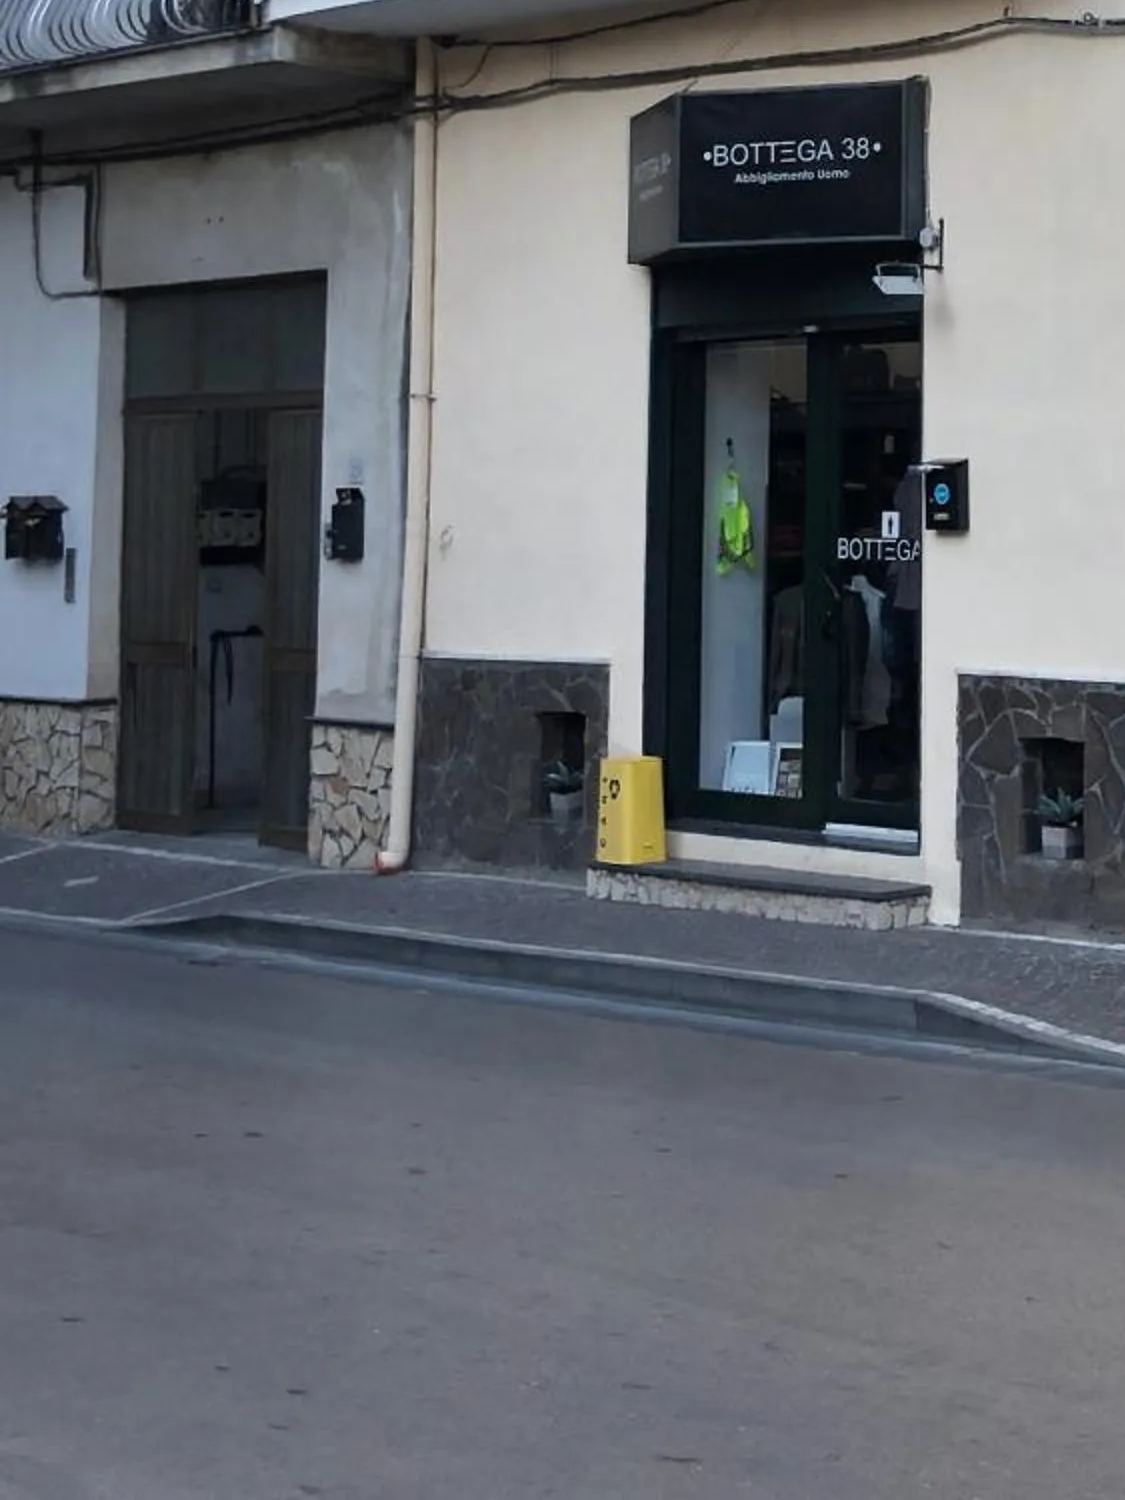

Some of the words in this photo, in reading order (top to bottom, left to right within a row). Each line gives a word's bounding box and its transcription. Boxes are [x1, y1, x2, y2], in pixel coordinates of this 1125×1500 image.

[713, 139, 834, 167] BOTTEGA
[841, 137, 869, 159] 38
[735, 169, 814, 185] Abbigliamento
[817, 169, 850, 180] Uomo
[837, 537, 922, 560] BOTTEGA
